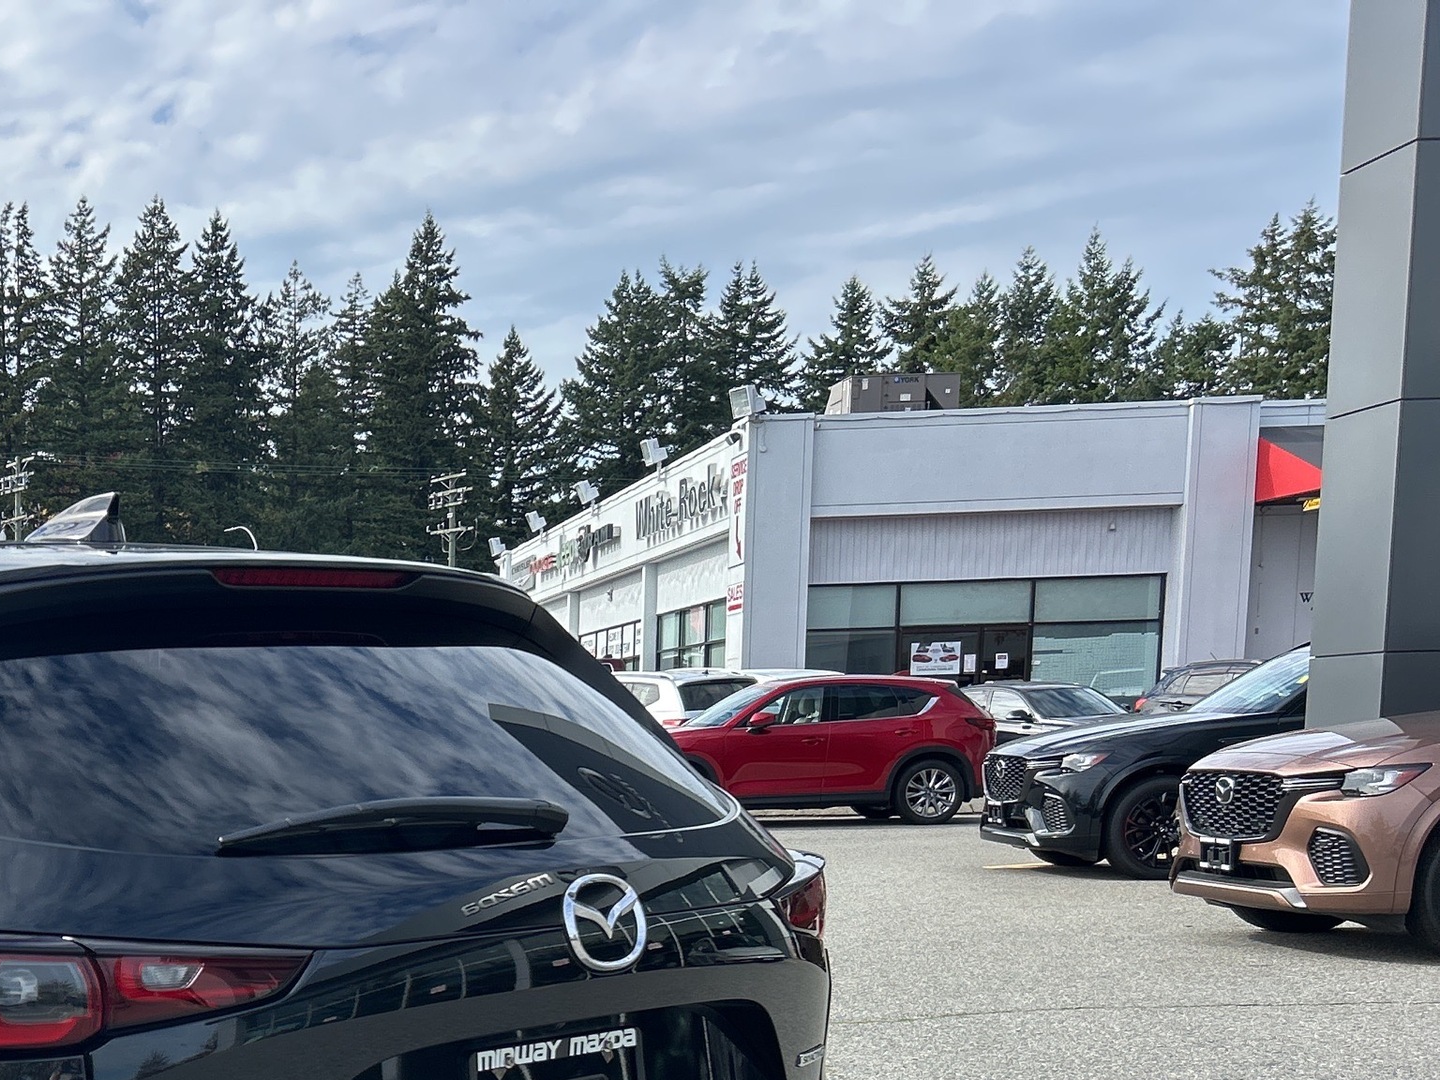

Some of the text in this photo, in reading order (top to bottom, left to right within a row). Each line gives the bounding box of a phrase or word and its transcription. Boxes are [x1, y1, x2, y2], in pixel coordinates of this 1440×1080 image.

[635, 463, 717, 540] White Rock
[727, 584, 743, 602] SALES
